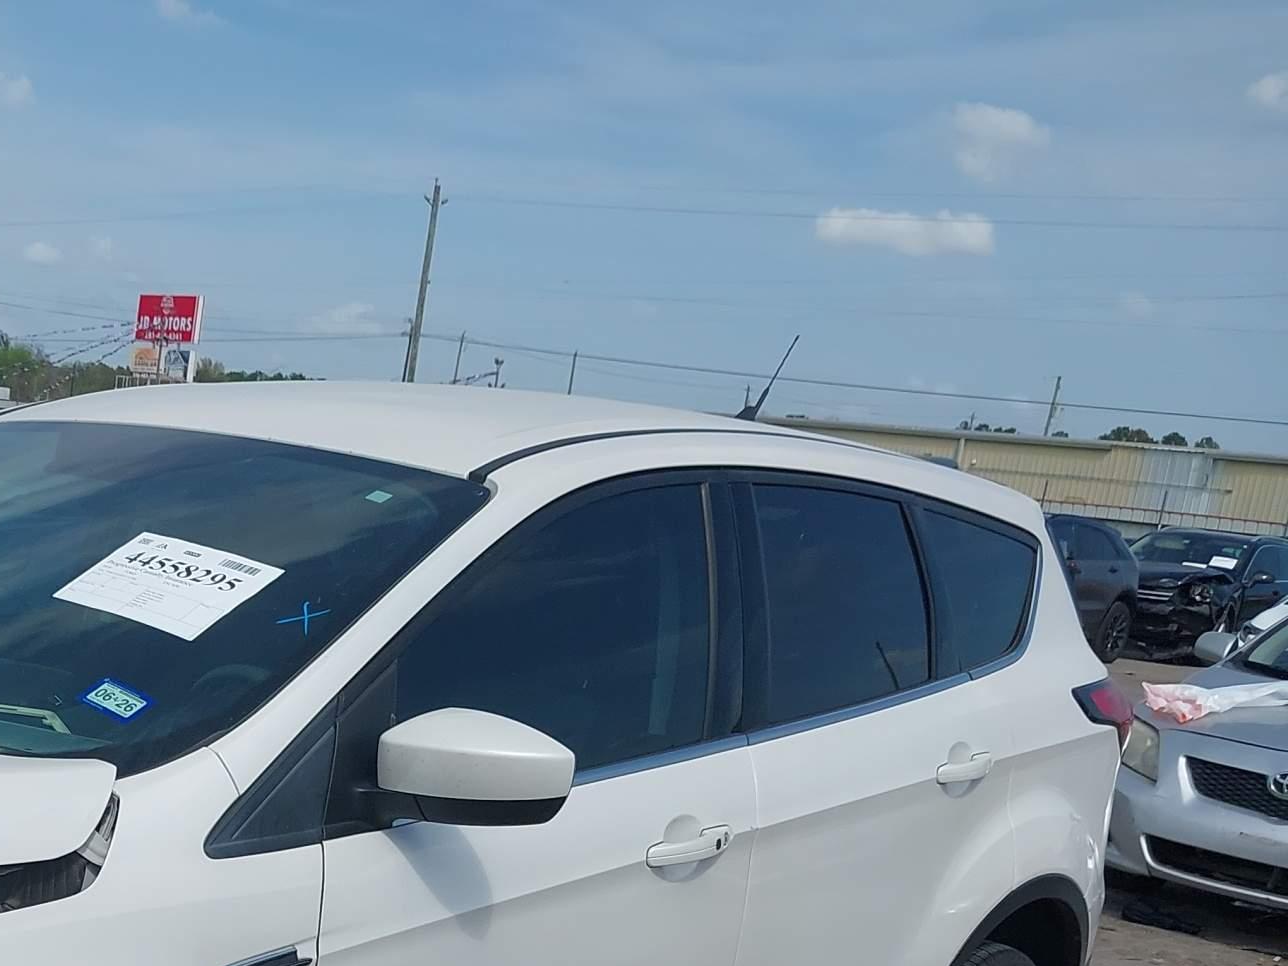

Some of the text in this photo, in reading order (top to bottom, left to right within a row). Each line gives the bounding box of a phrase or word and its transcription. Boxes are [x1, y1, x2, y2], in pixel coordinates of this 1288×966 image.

[138, 315, 150, 330] JD
[124, 551, 244, 592] 44558295
[94, 688, 116, 702] 06
[114, 698, 138, 713] 26
